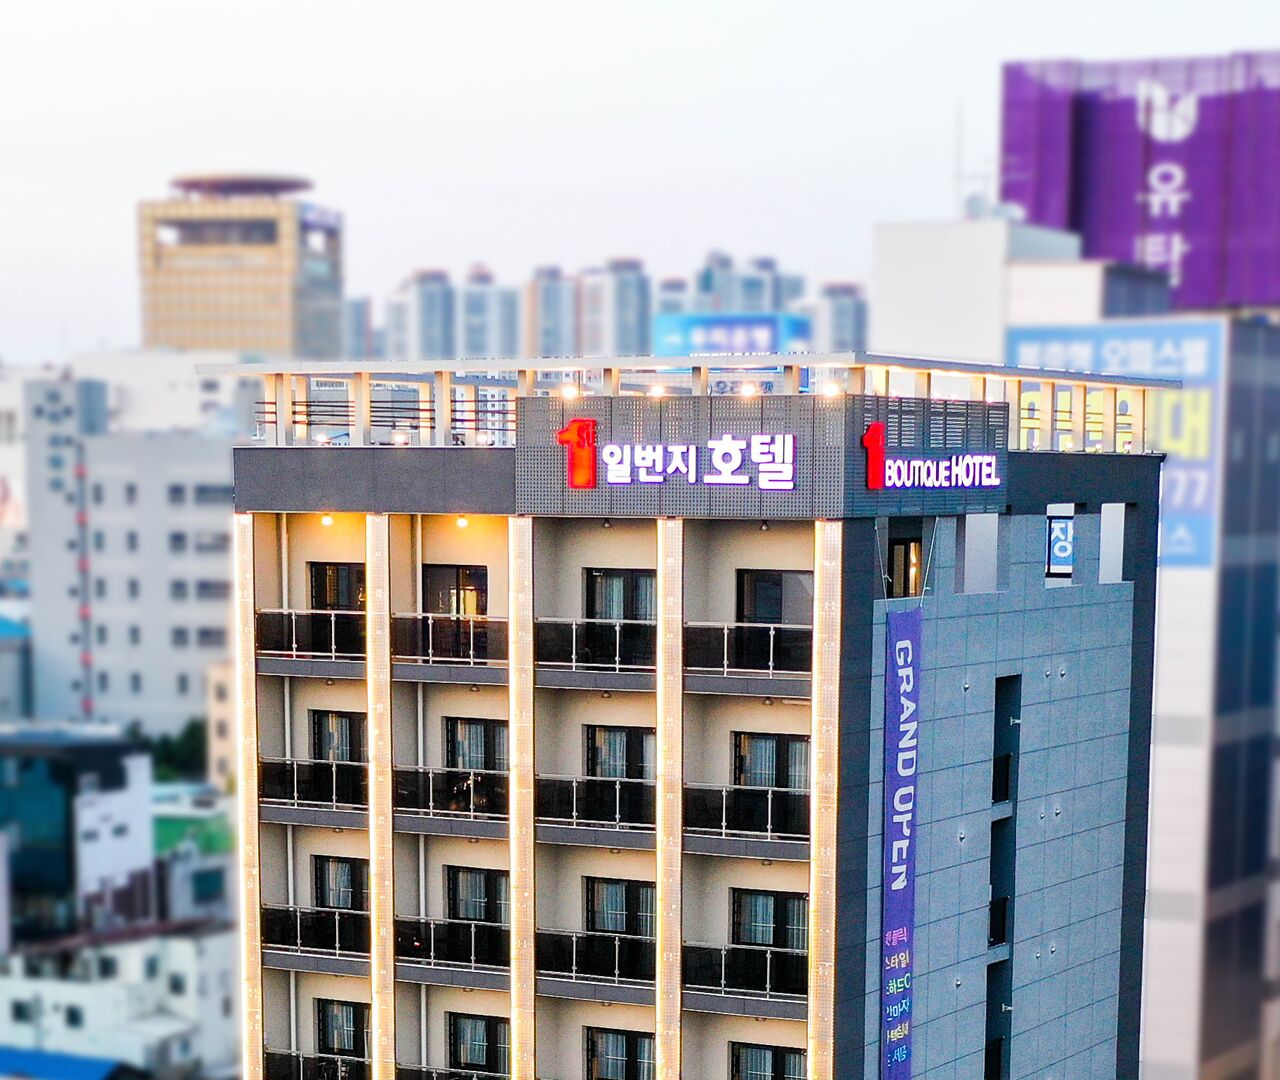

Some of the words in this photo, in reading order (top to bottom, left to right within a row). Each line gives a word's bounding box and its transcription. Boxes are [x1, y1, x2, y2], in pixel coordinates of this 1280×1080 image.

[602, 444, 697, 485] 일번지
[703, 433, 796, 490] 호텔
[885, 459, 951, 488] BOUTIQUE
[951, 454, 1001, 488] HOTEL
[895, 639, 918, 777] GRAND
[890, 785, 915, 891] OPEN
